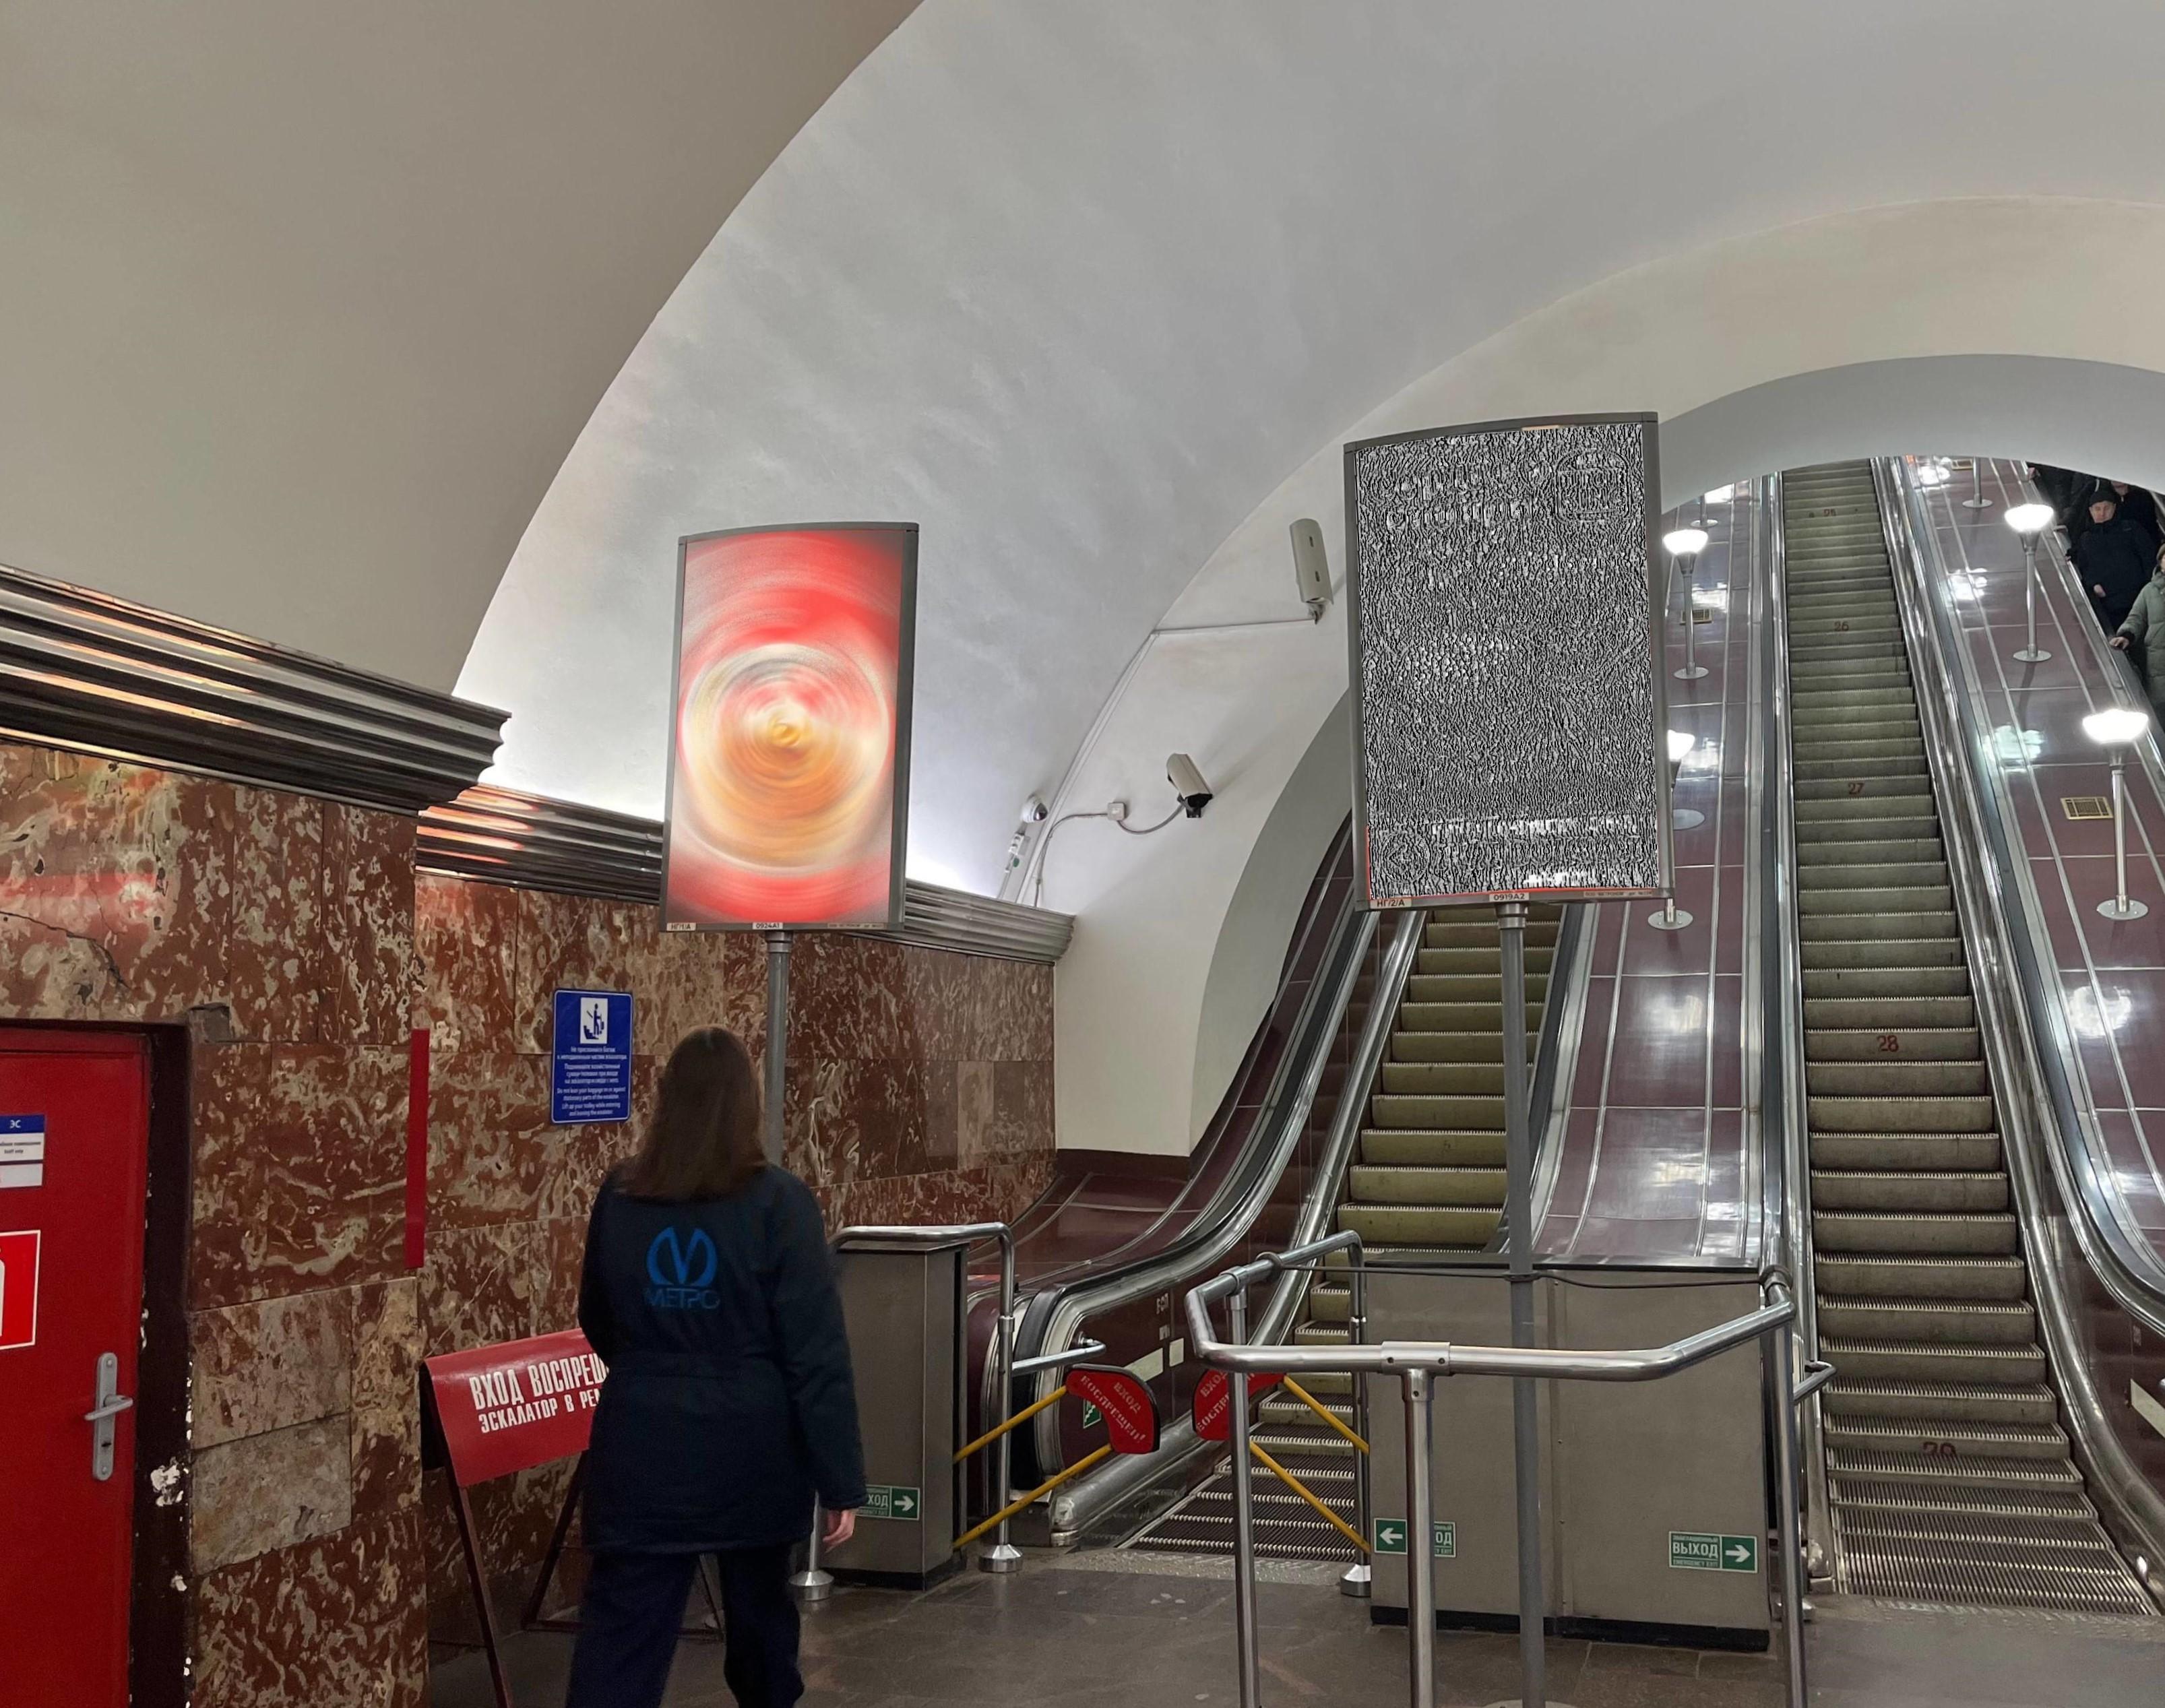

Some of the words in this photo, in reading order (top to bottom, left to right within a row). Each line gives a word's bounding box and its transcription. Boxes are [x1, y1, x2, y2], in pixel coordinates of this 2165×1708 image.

[1834, 621, 1849, 632] 26
[1848, 782, 1865, 795] 27
[1877, 1034, 1899, 1052] 28
[469, 1368, 524, 1410] ВХОД
[528, 1352, 610, 1397] ВОСПРЕЩ
[1113, 1382, 1141, 1414] ВХОД
[478, 1397, 559, 1434] ЭСКАЛАТОР
[564, 1394, 575, 1413] В
[1672, 1542, 1718, 1558] ВЫХОД
